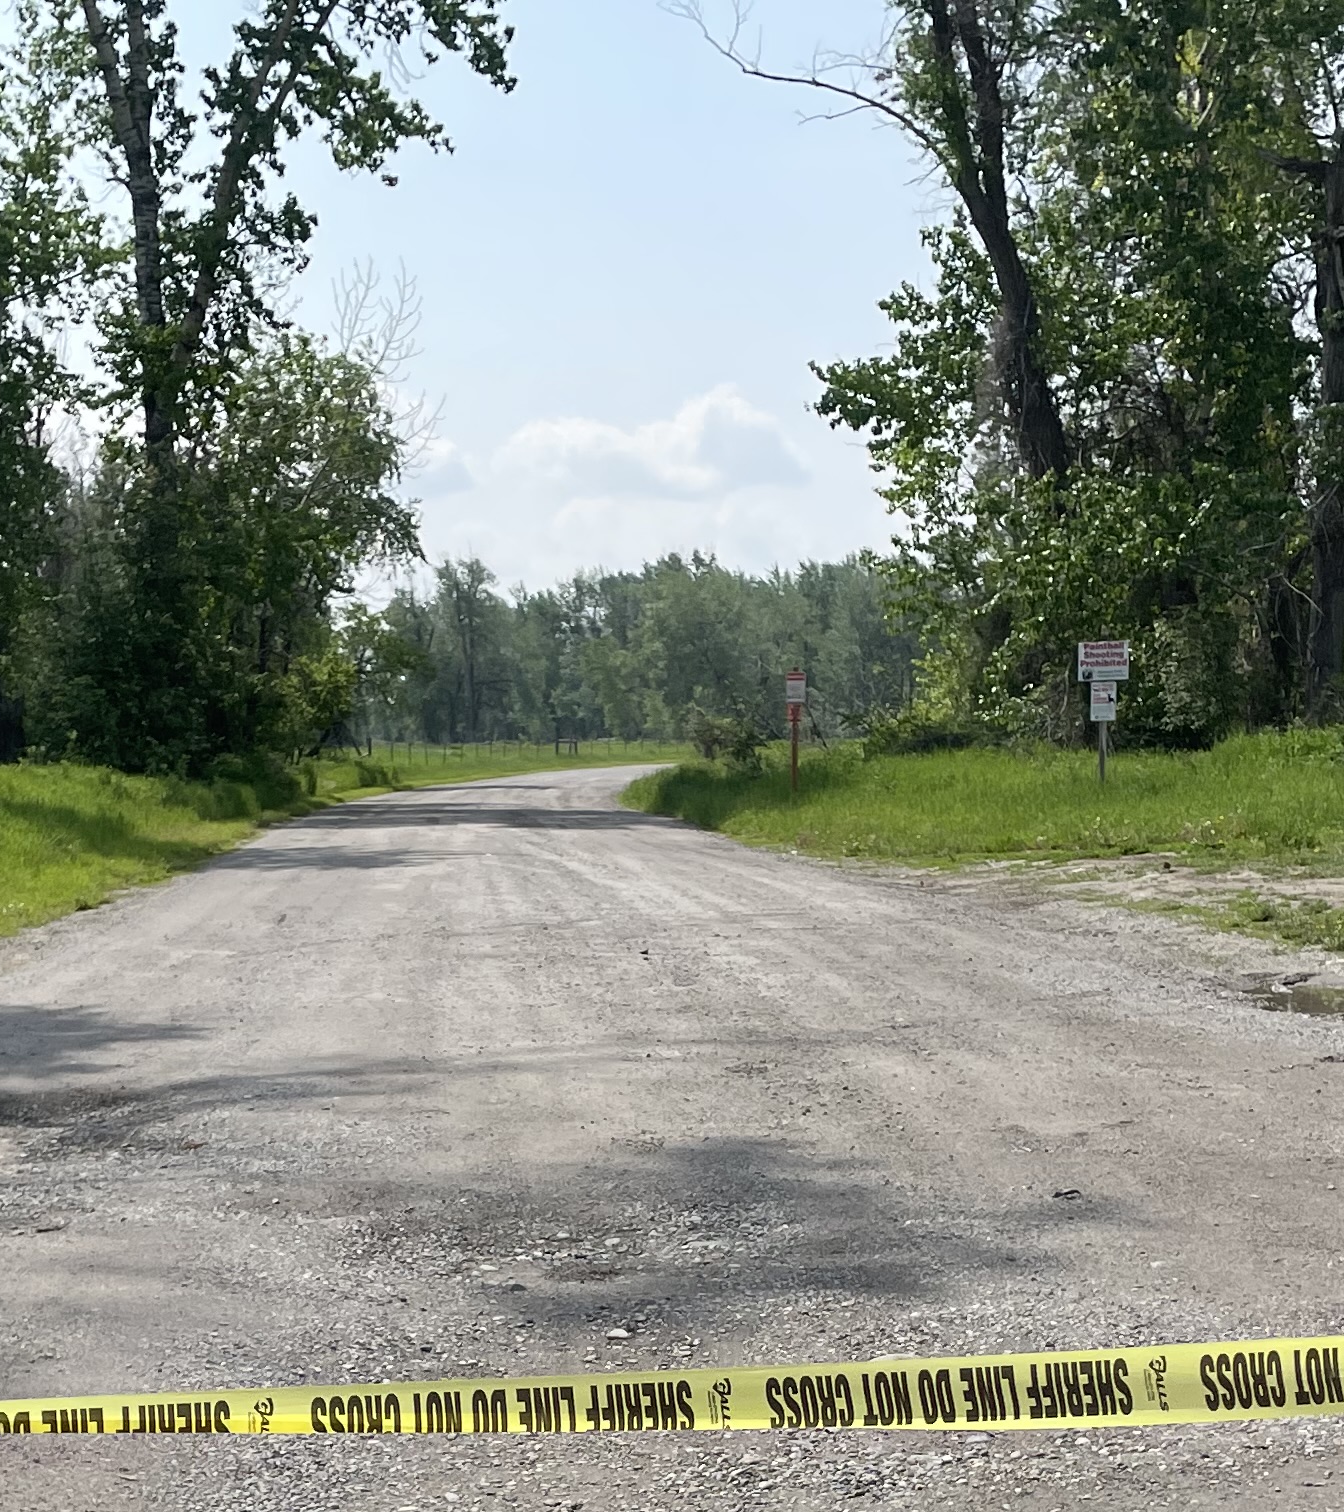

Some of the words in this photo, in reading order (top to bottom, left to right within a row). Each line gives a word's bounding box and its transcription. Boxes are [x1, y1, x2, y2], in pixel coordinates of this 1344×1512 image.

[1080, 659, 1127, 667] Prohibited
[1084, 642, 1124, 650] Paintball
[1084, 651, 1124, 659] Shooting
[765, 1373, 855, 1429] CROSS
[861, 1370, 913, 1427] NOT
[918, 1368, 956, 1424] DO
[960, 1365, 1020, 1422] LINE
[1027, 1357, 1133, 1419] SHERIFF
[1199, 1350, 1286, 1412] CROSS
[1293, 1347, 1344, 1405] NOT
[311, 1393, 401, 1433] CROSS
[413, 1391, 462, 1433] NOT
[472, 1388, 508, 1433] DO
[516, 1385, 578, 1433] LINE
[586, 1379, 695, 1431] SHERIFF
[712, 1377, 732, 1431] GALL
